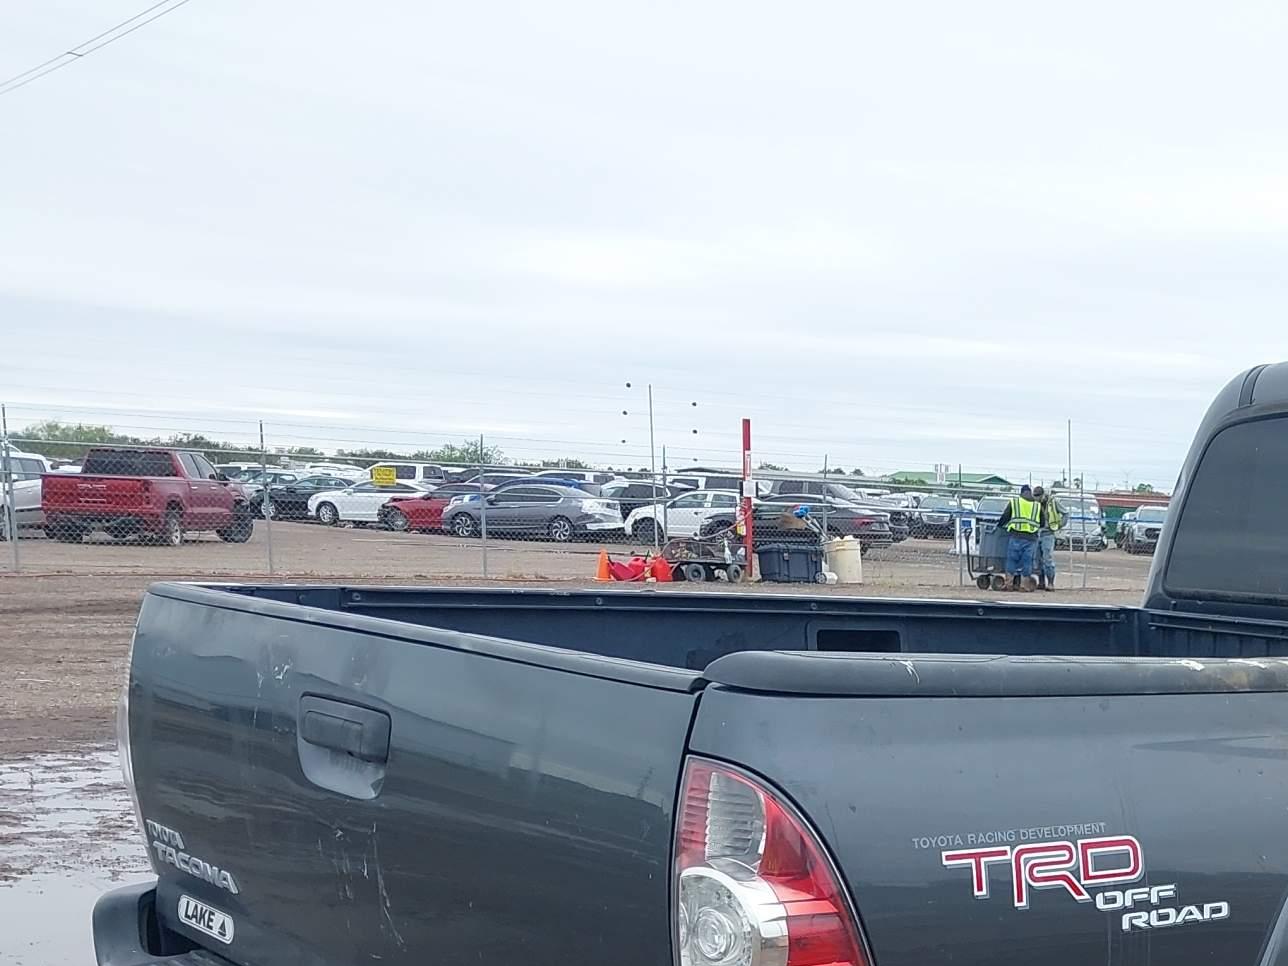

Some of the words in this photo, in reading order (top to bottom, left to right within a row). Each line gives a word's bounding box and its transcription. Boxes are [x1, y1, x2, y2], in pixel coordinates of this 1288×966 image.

[912, 834, 963, 849] TOYOTA
[968, 829, 1016, 845] RACING
[1020, 822, 1106, 840] DEVELOPMENT
[153, 841, 238, 894] TACOMA
[942, 835, 1144, 908] TRD
[1096, 884, 1177, 910] OFF
[184, 900, 215, 930] LAKE
[1122, 901, 1230, 931] ROAD
